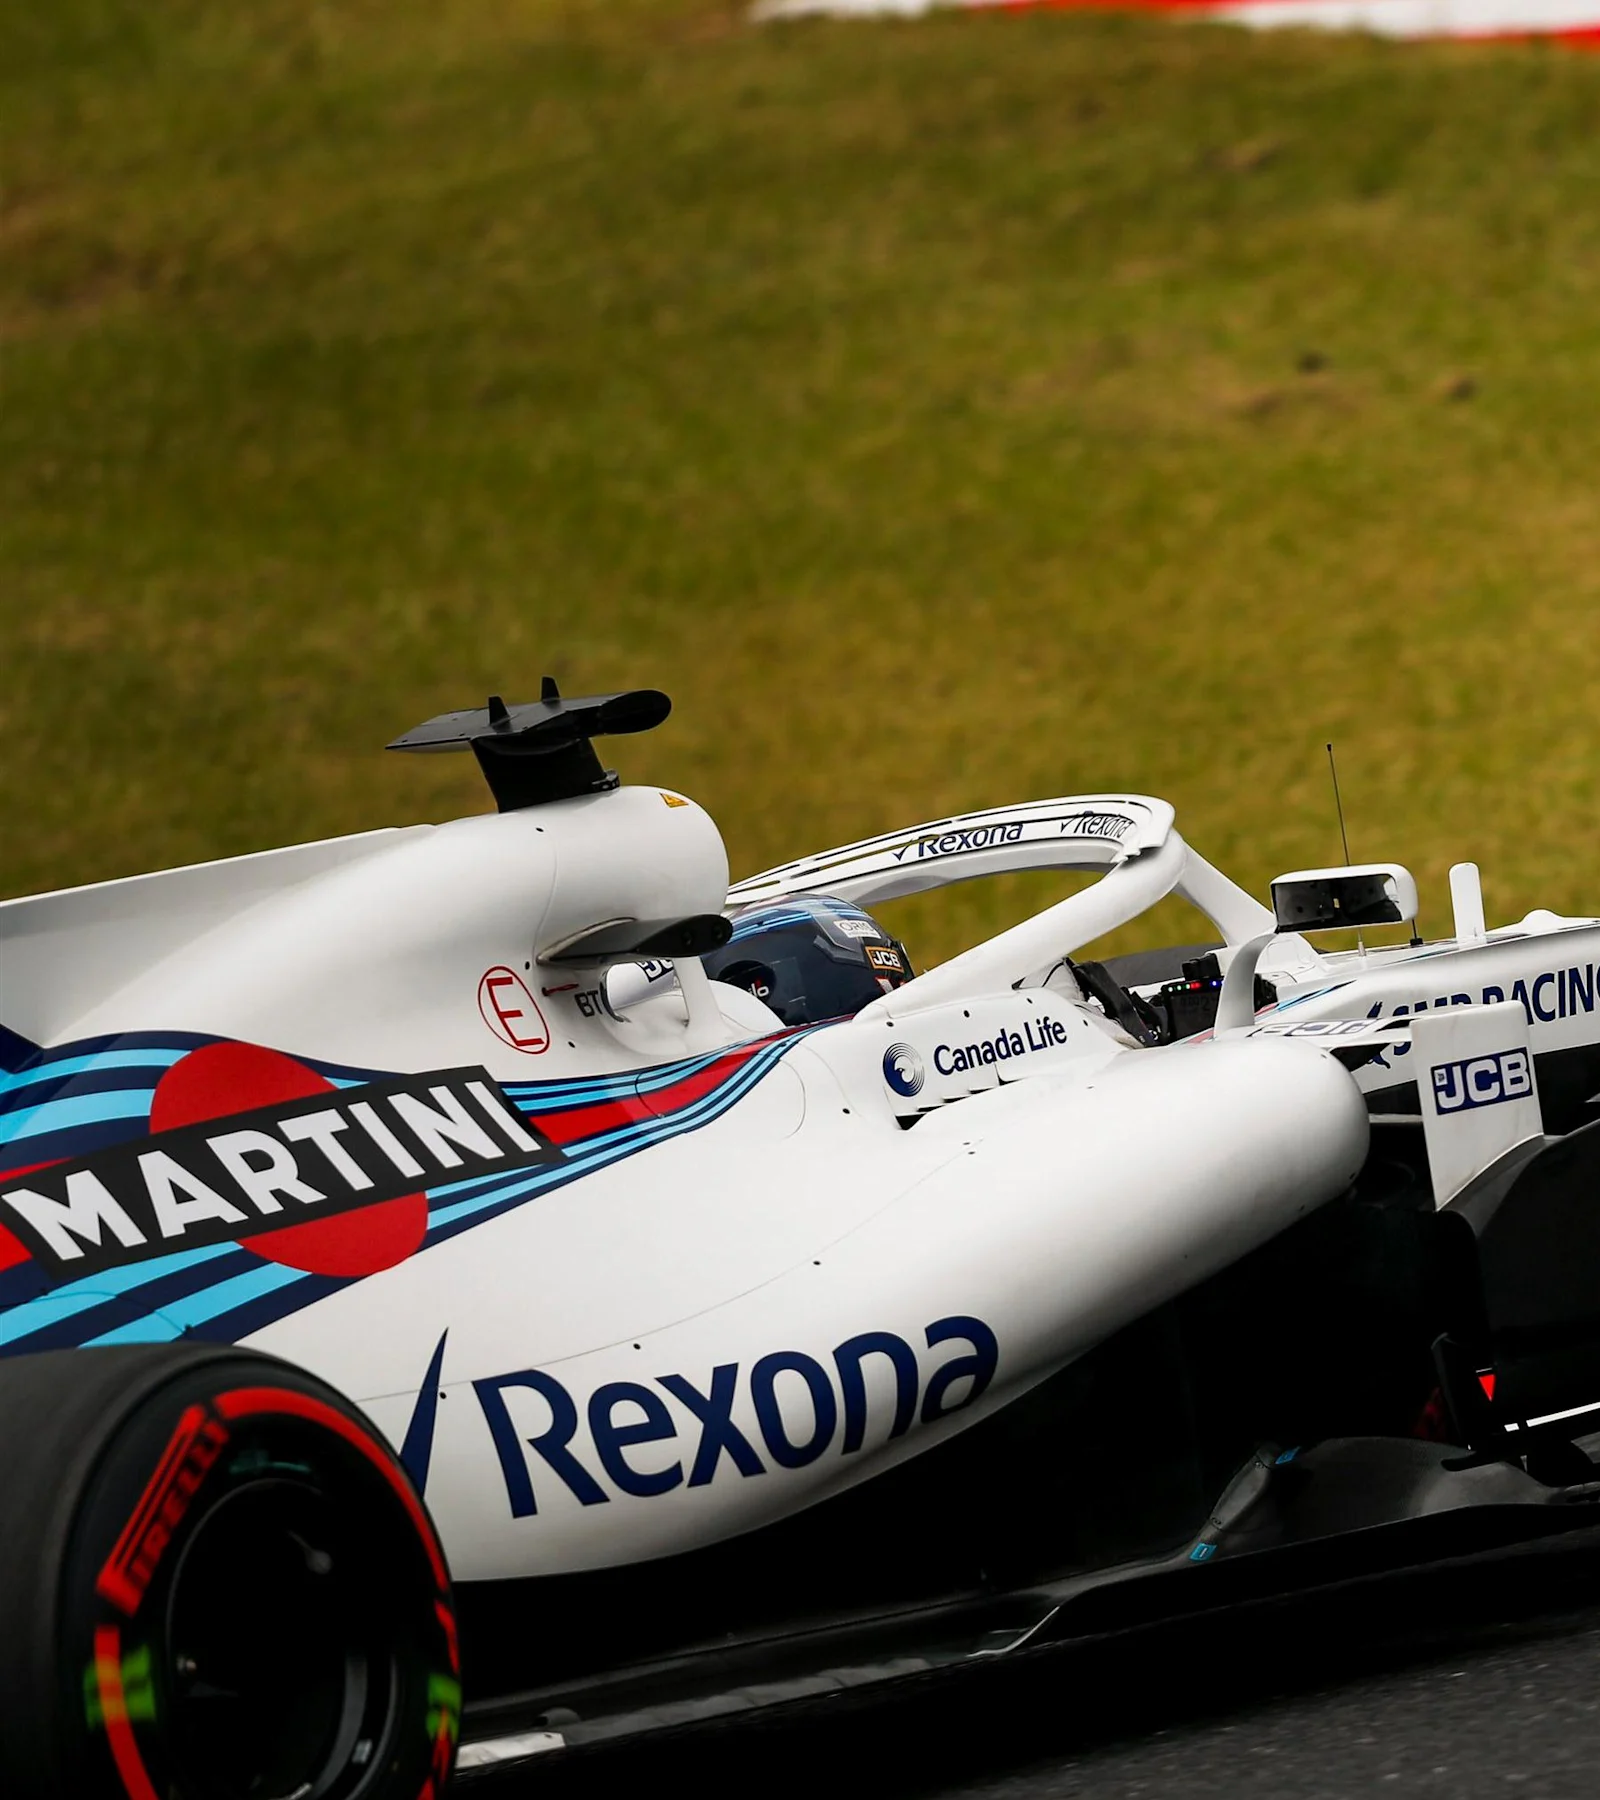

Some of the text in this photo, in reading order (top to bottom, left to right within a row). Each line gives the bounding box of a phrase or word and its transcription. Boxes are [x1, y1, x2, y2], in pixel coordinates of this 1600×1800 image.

[918, 823, 1023, 857] Rexona
[1073, 811, 1133, 839] Rexona
[874, 951, 901, 967] JCB
[486, 977, 545, 1047] E
[934, 1016, 1067, 1076] Canada Life
[1436, 1051, 1531, 1110] JCB
[1, 1081, 541, 1261] MARTINI
[472, 1316, 998, 1519] Rexona
